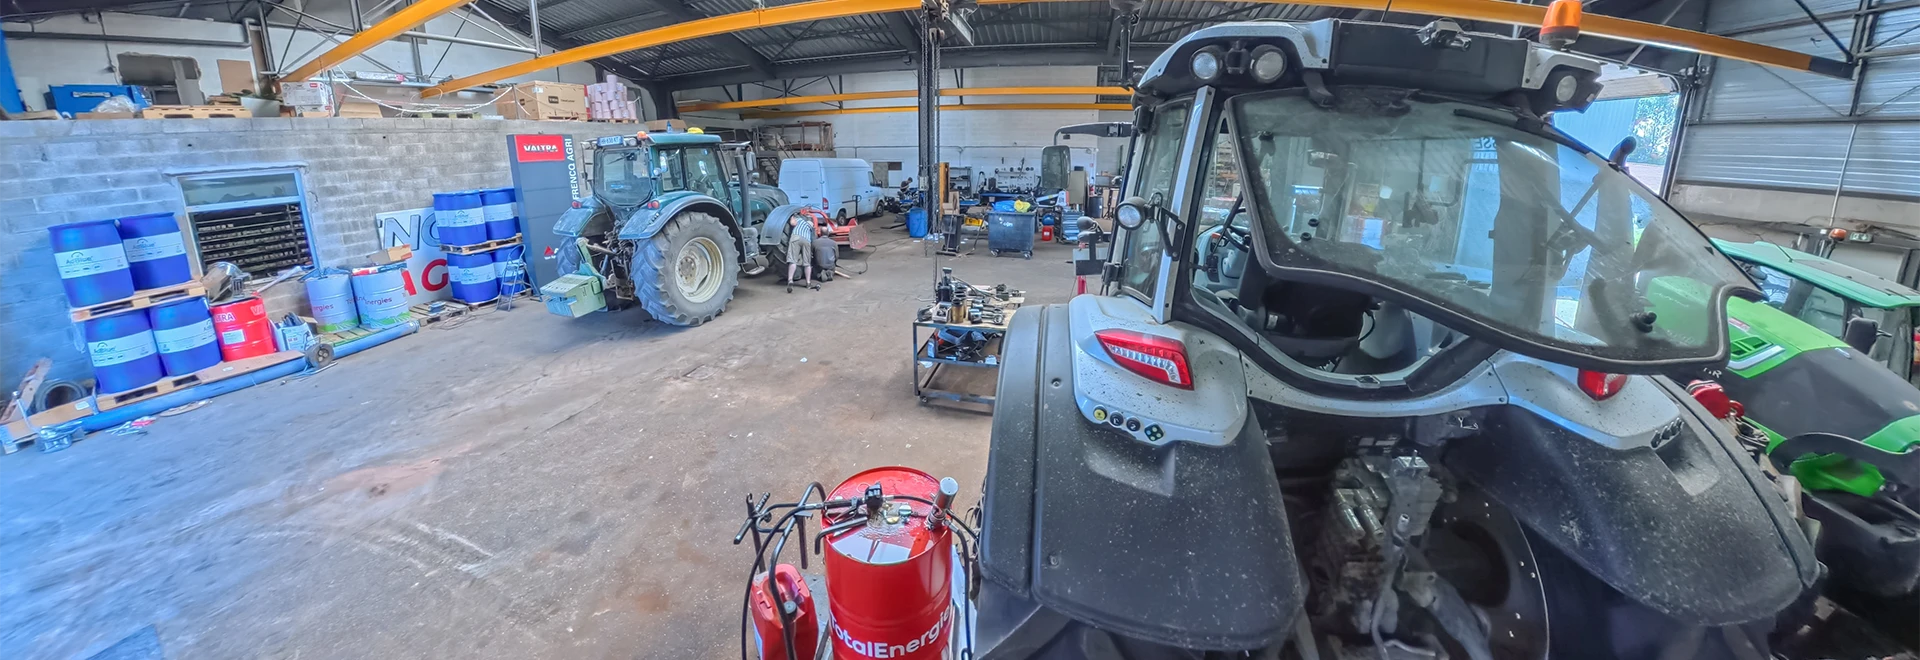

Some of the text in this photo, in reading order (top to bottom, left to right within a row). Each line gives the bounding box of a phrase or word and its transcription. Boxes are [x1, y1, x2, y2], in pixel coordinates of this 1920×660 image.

[523, 143, 559, 153] VALTRA
[564, 138, 576, 161] AGRI
[829, 604, 953, 659] TotalEnergie
